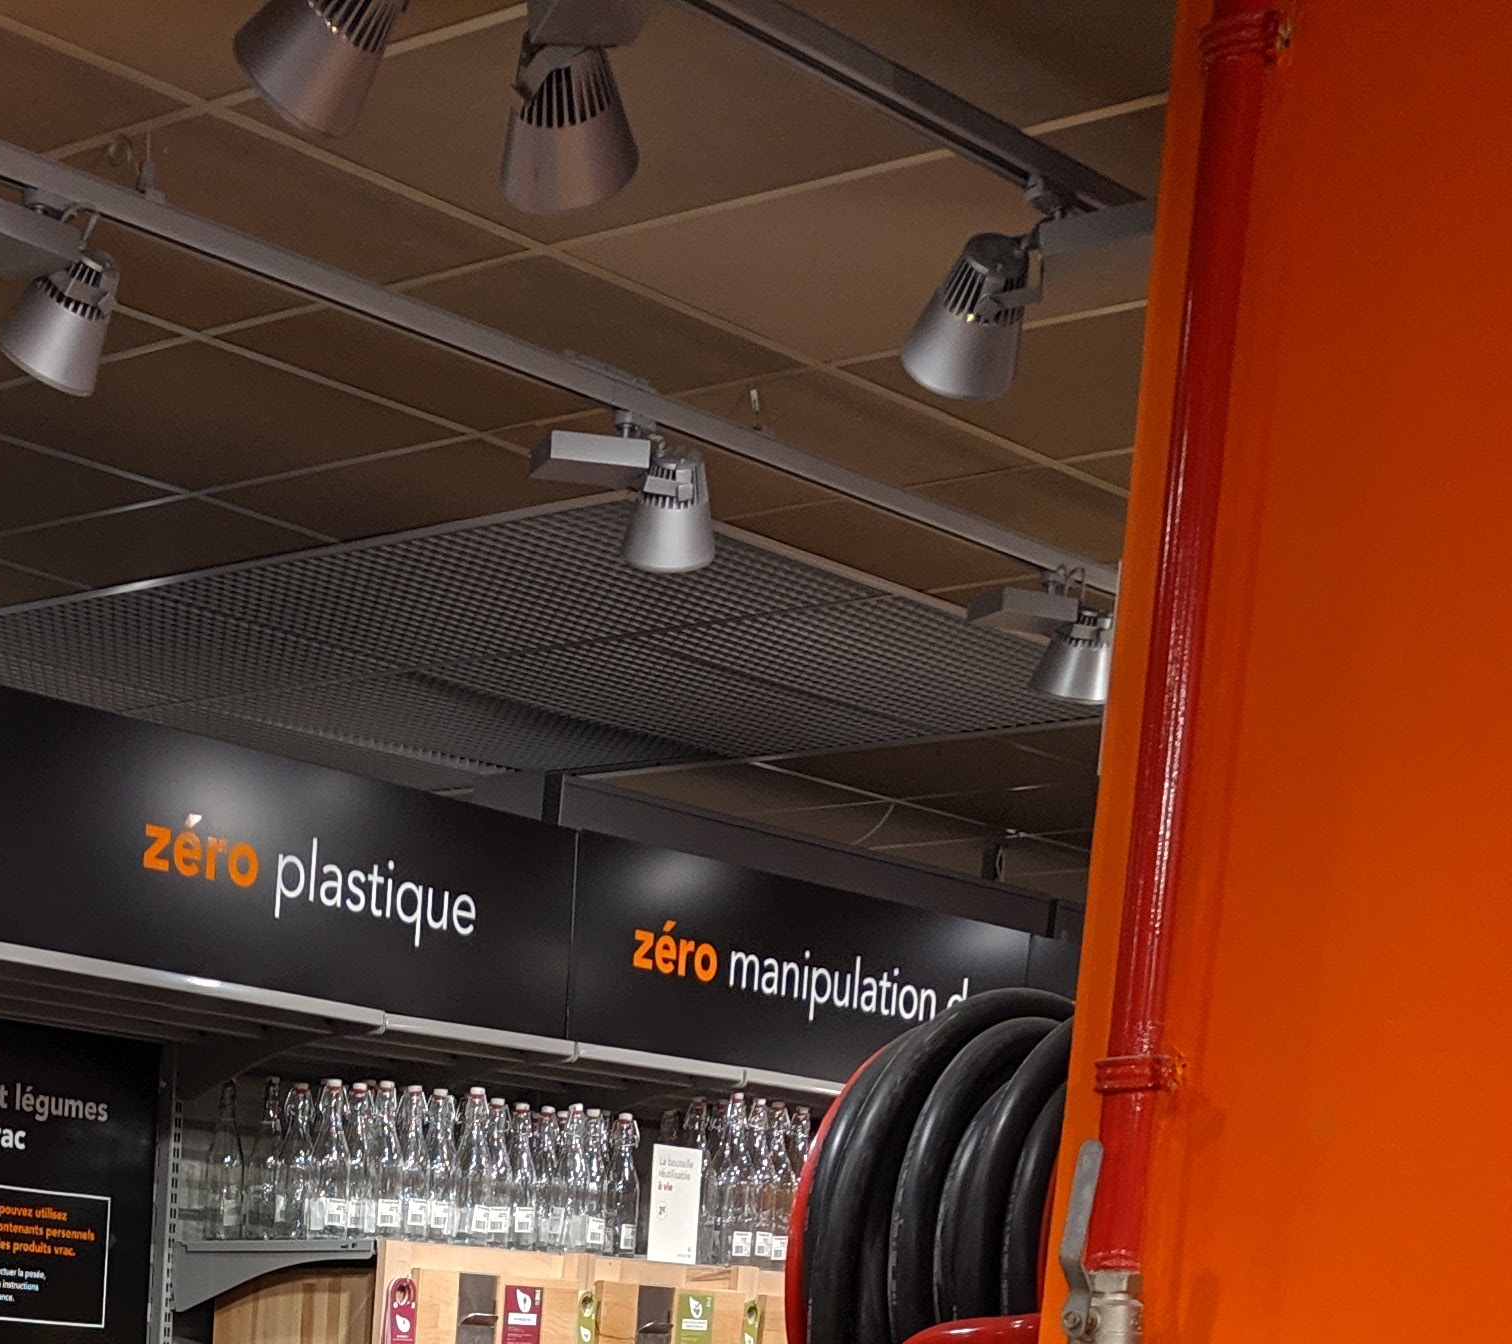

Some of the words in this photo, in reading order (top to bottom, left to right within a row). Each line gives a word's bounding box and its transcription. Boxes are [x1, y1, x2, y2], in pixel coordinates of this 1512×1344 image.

[143, 813, 259, 887] zéro
[274, 838, 476, 948] plastique
[632, 920, 717, 982] zéro
[729, 951, 937, 1021] manipulation
[15, 1082, 108, 1122] légumes
[0, 1206, 33, 1218] pouvez
[35, 1207, 67, 1221] utilisez
[13, 1240, 51, 1254] produits
[46, 1228, 95, 1241] personnels
